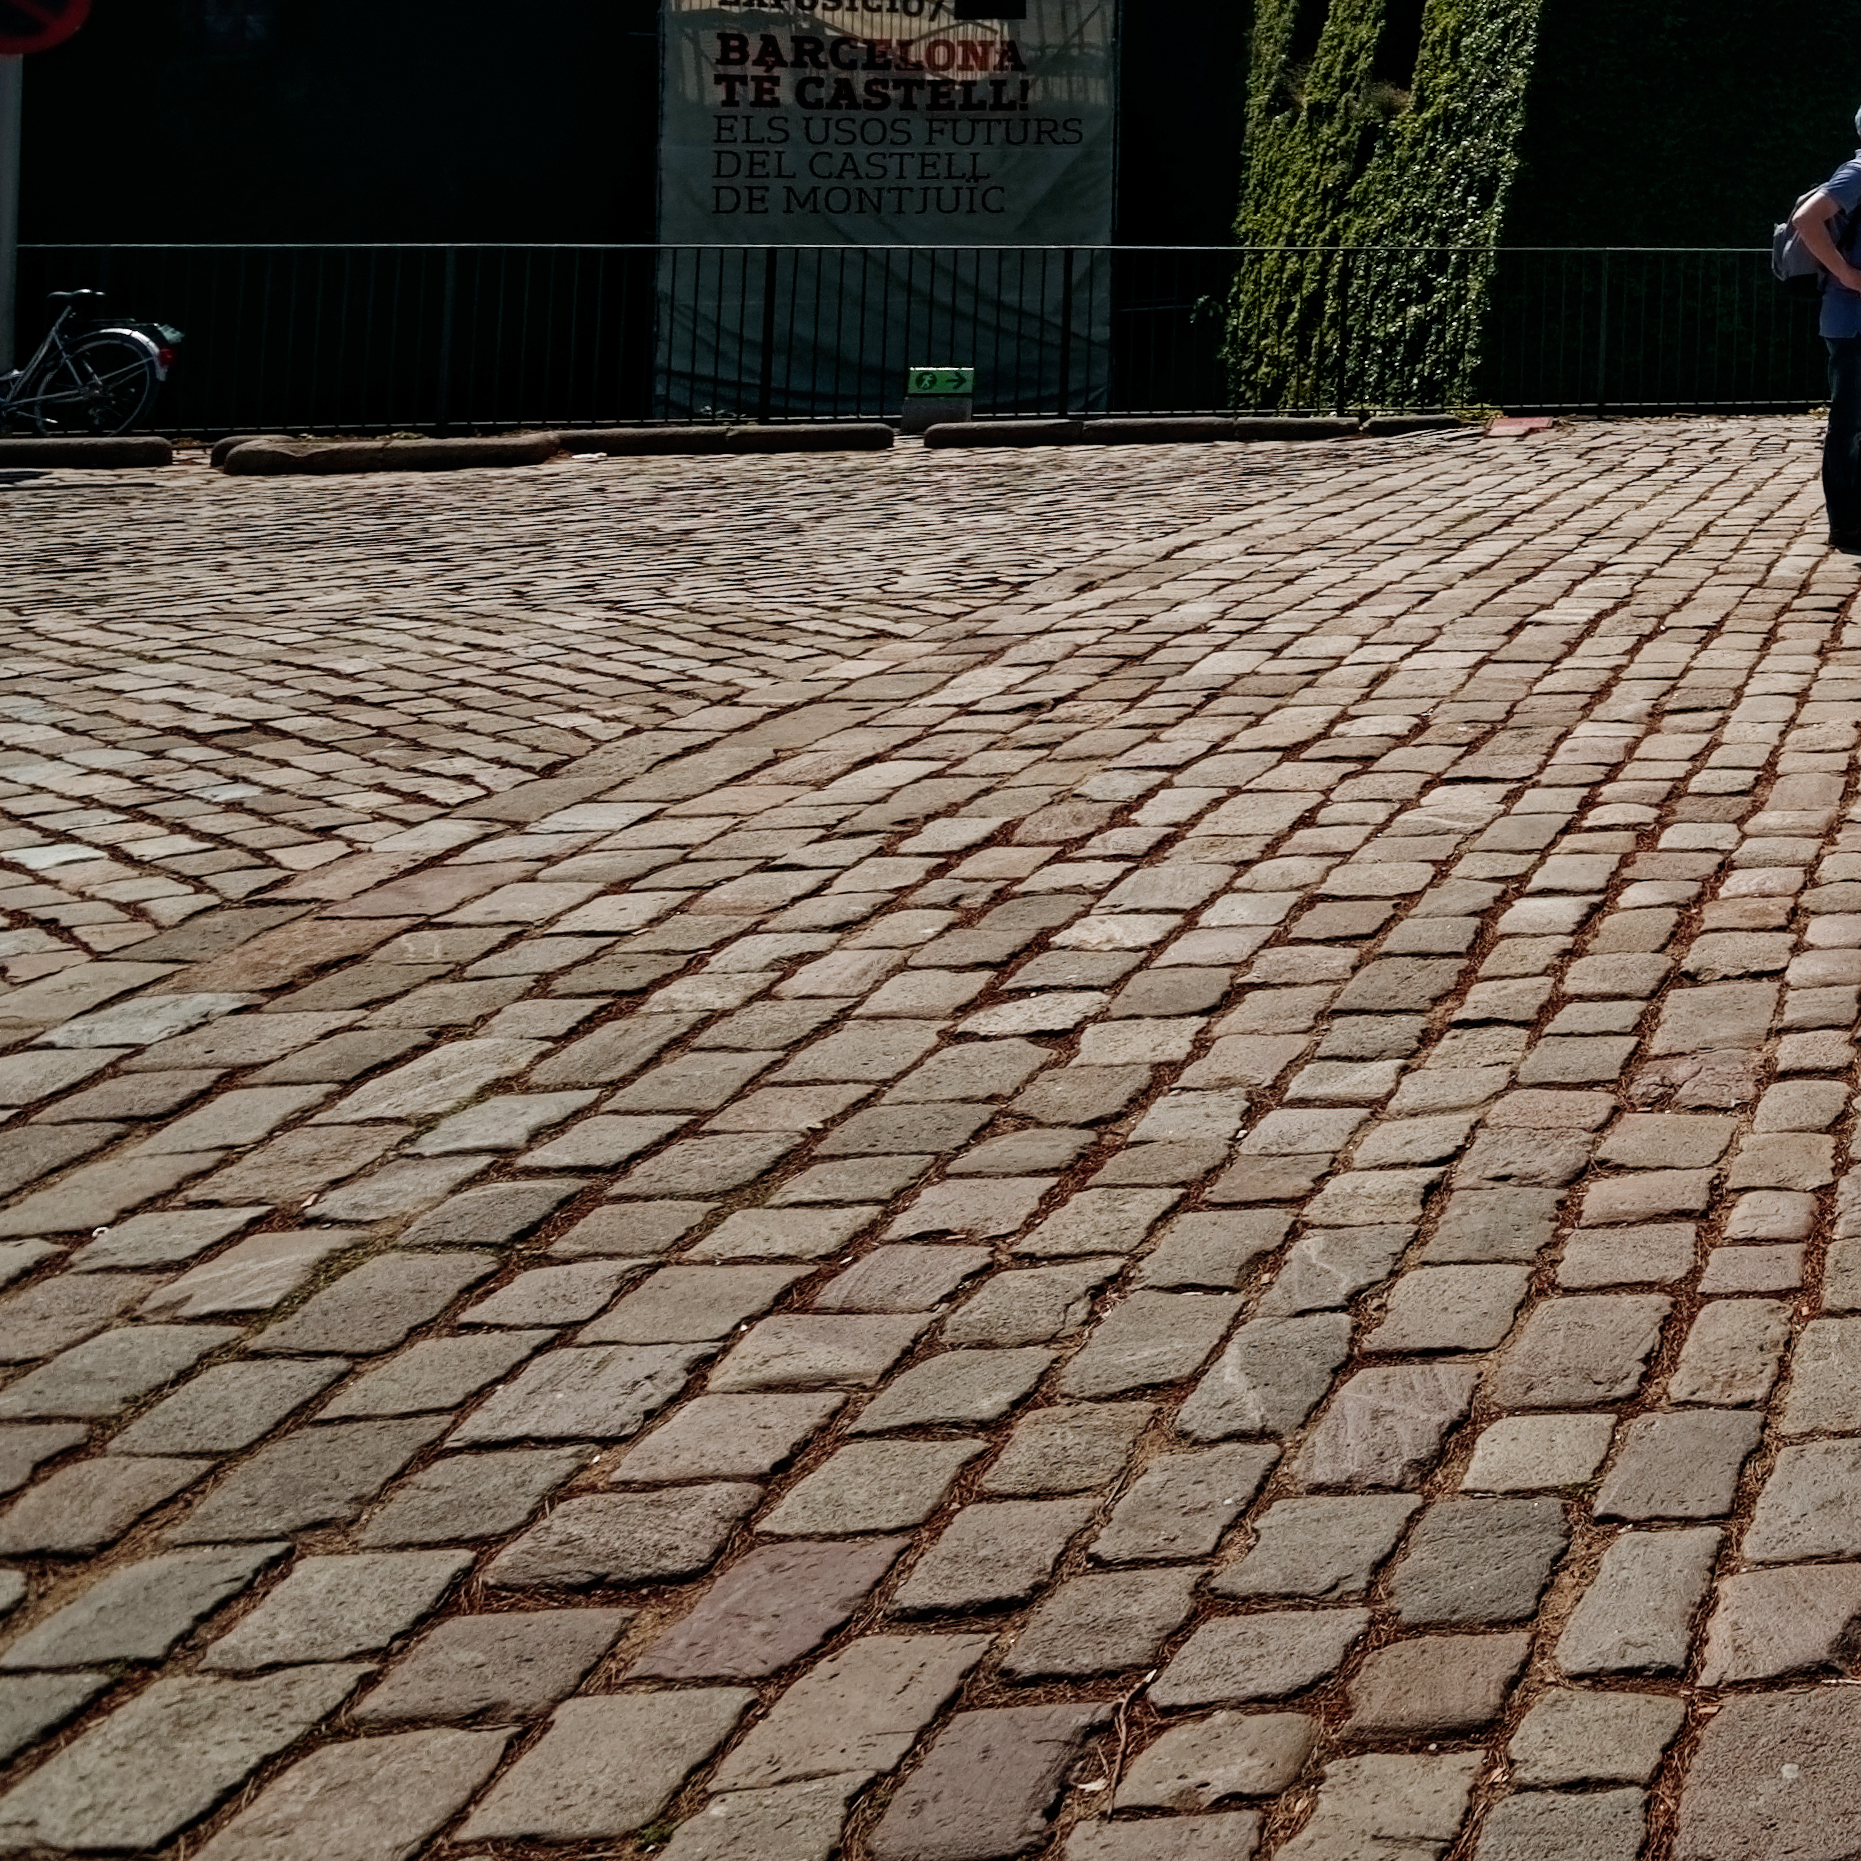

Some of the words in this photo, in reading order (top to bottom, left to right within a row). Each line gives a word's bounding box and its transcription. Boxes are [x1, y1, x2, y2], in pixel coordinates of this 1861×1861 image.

[716, 33, 1026, 71] BARCELONA
[715, 64, 781, 108] TÉ
[795, 76, 1030, 111] CASTELL!
[714, 115, 789, 143] ELS
[803, 117, 911, 145] USOS
[925, 118, 1083, 145] FUTURS
[713, 150, 796, 178] DEL
[809, 152, 990, 180] CASTELL
[712, 186, 769, 214] DE
[783, 178, 1005, 214] MONTJUÏC
